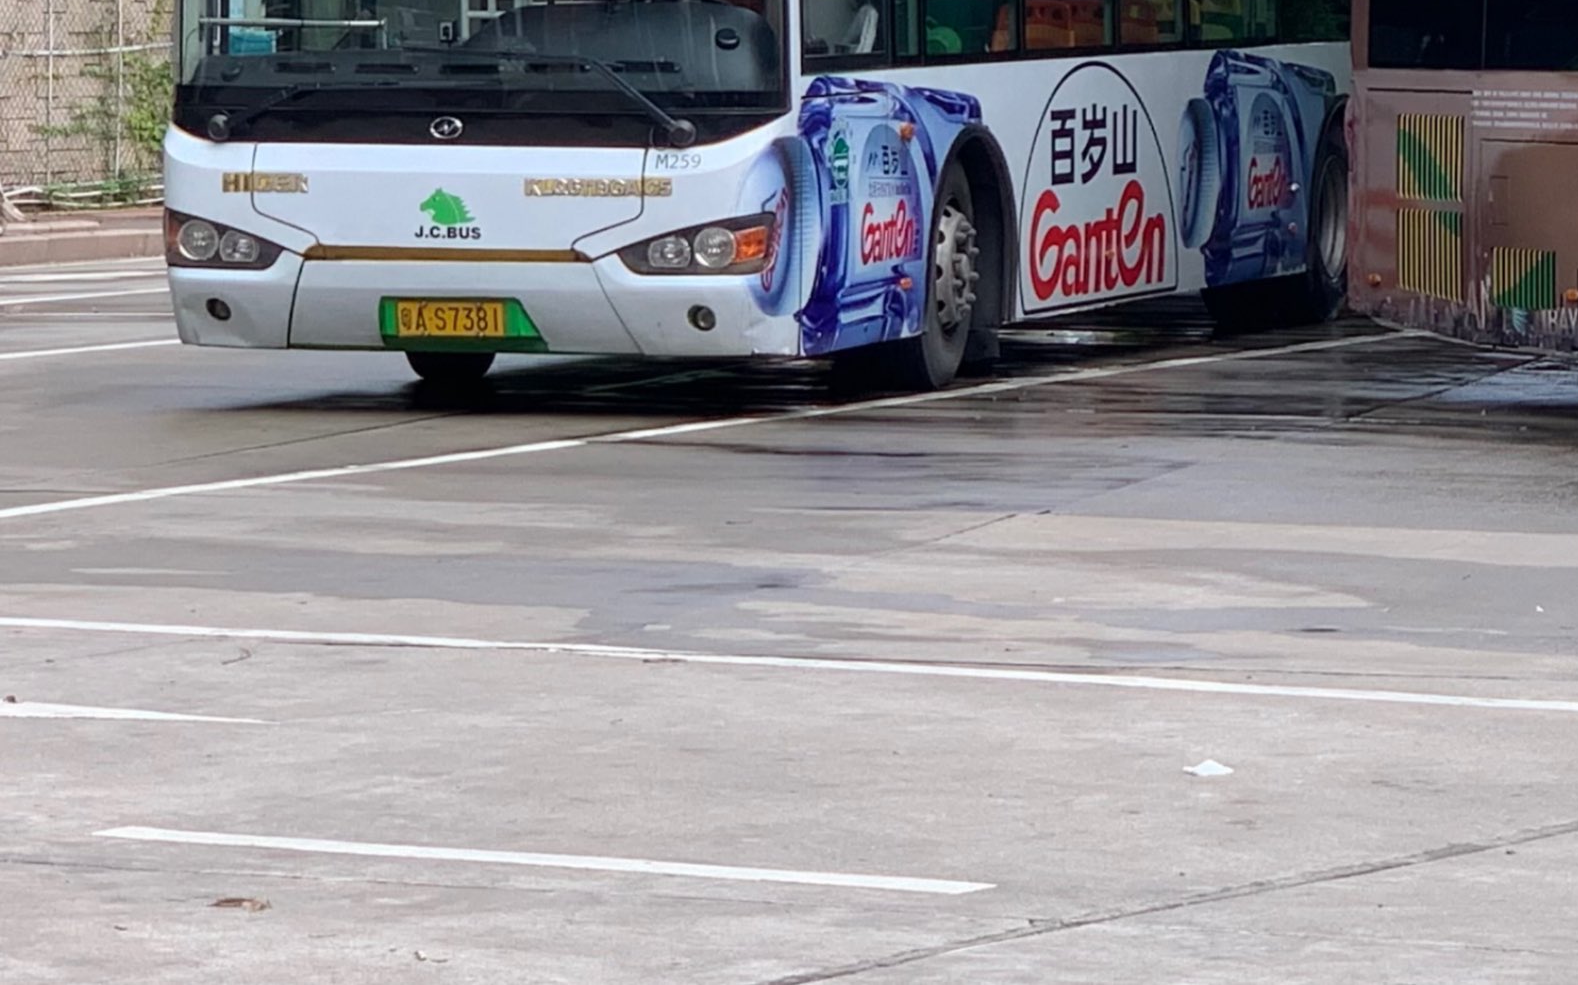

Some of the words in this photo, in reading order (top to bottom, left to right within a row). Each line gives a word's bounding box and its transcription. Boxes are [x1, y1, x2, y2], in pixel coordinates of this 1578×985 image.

[655, 153, 702, 170] M259
[1050, 103, 1138, 186] 百岁山
[414, 224, 482, 241] J.C.BUS
[861, 199, 914, 265] Ganten
[1030, 179, 1166, 301] Ganten
